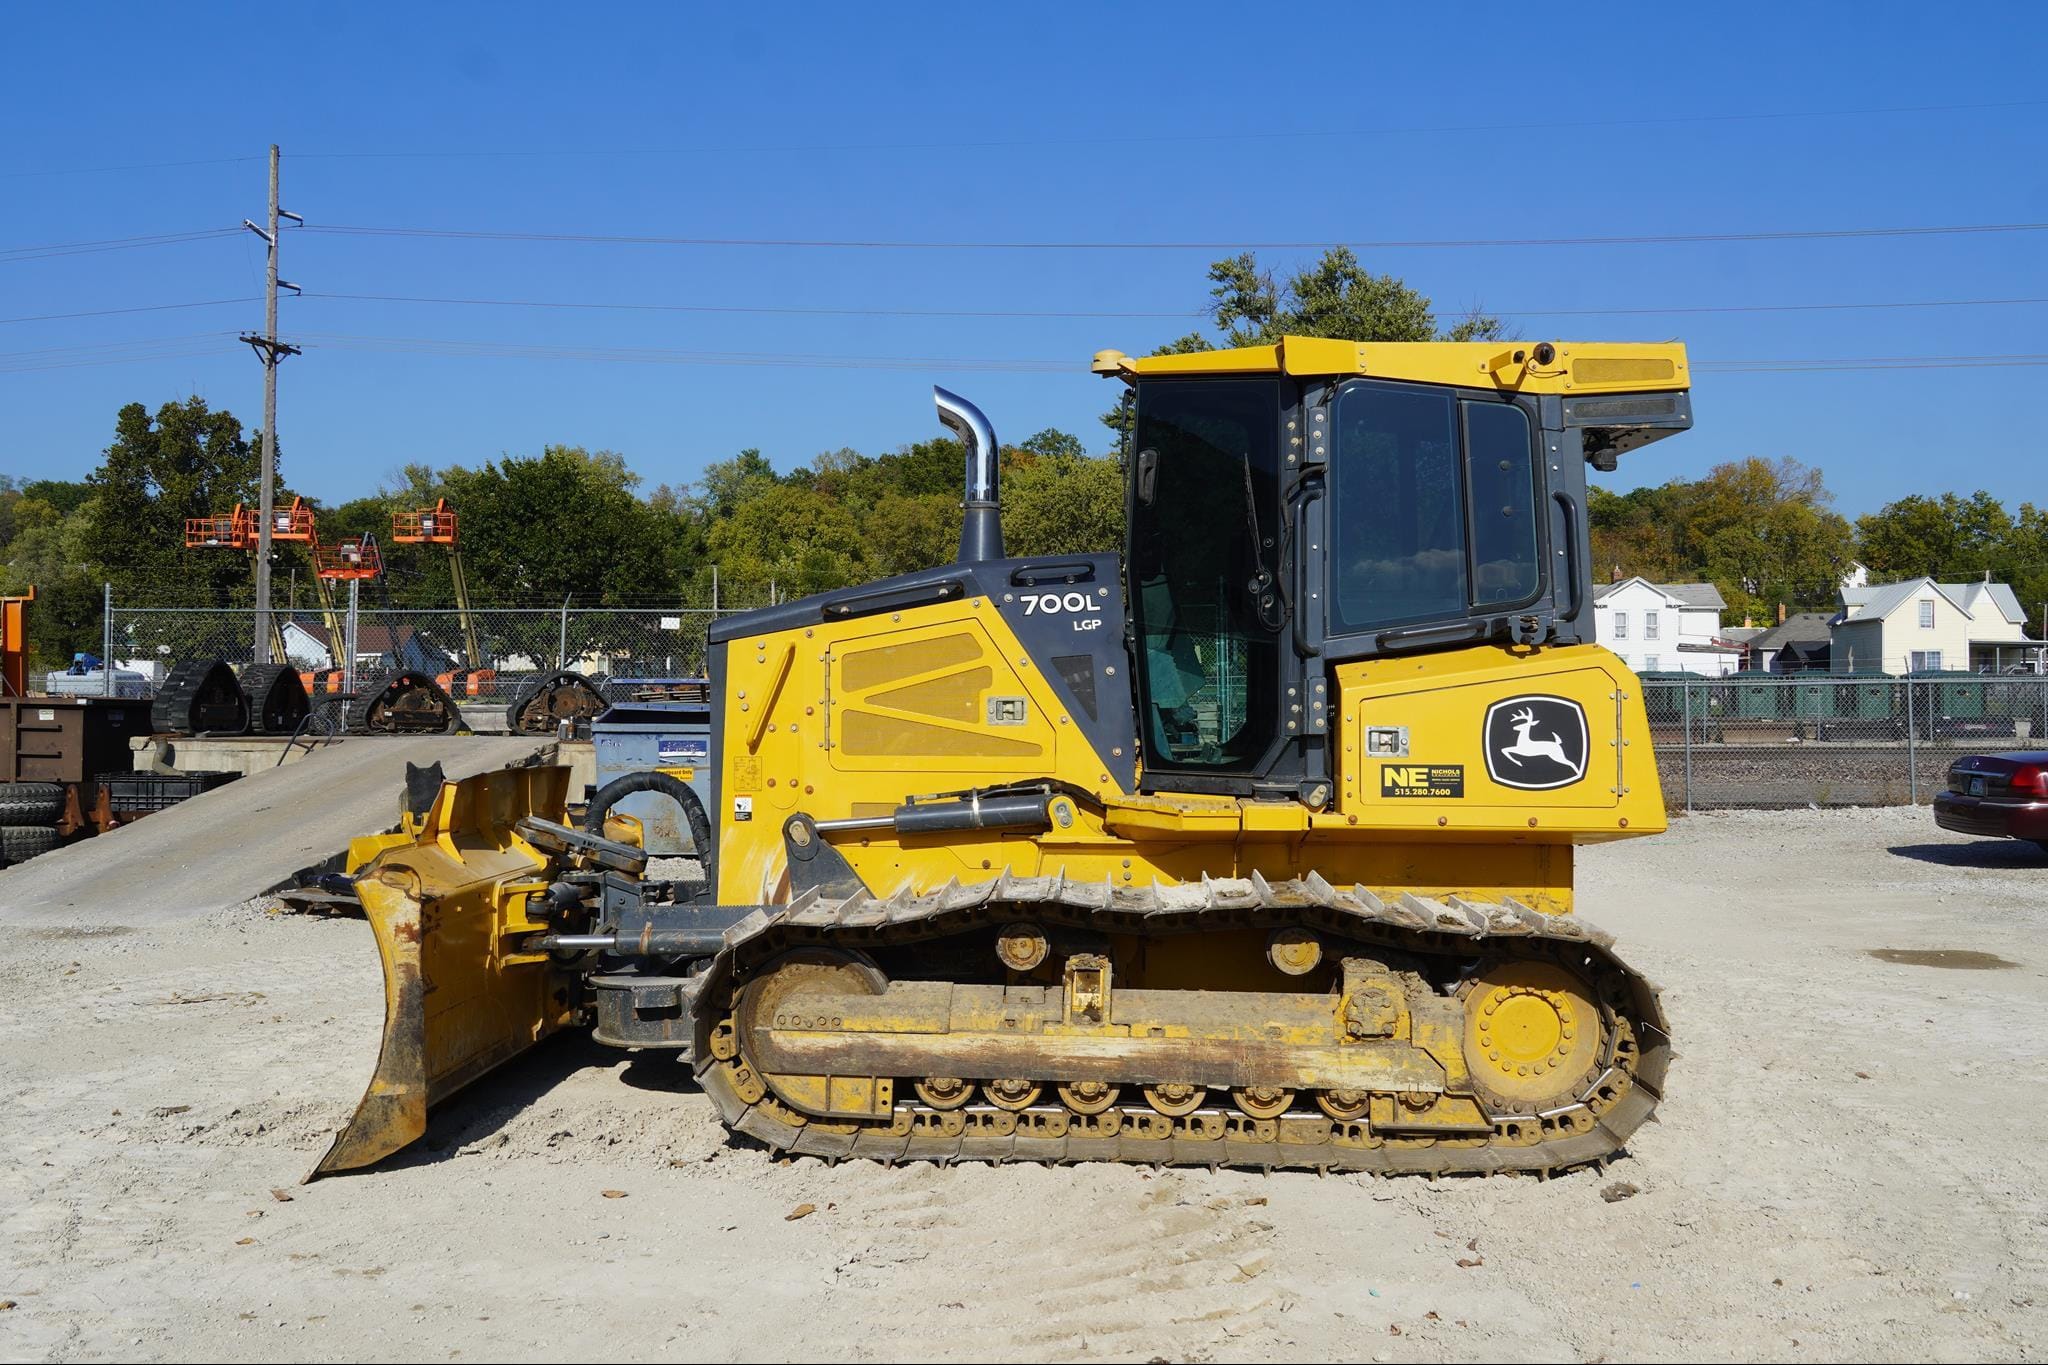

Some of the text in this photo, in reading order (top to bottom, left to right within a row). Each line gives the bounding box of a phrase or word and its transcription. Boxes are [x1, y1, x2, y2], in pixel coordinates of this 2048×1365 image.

[1020, 592, 1101, 616] 700L
[1073, 619, 1102, 631] LGP
[1384, 767, 1429, 787] NE
[1394, 788, 1451, 796] 515.280.7600
